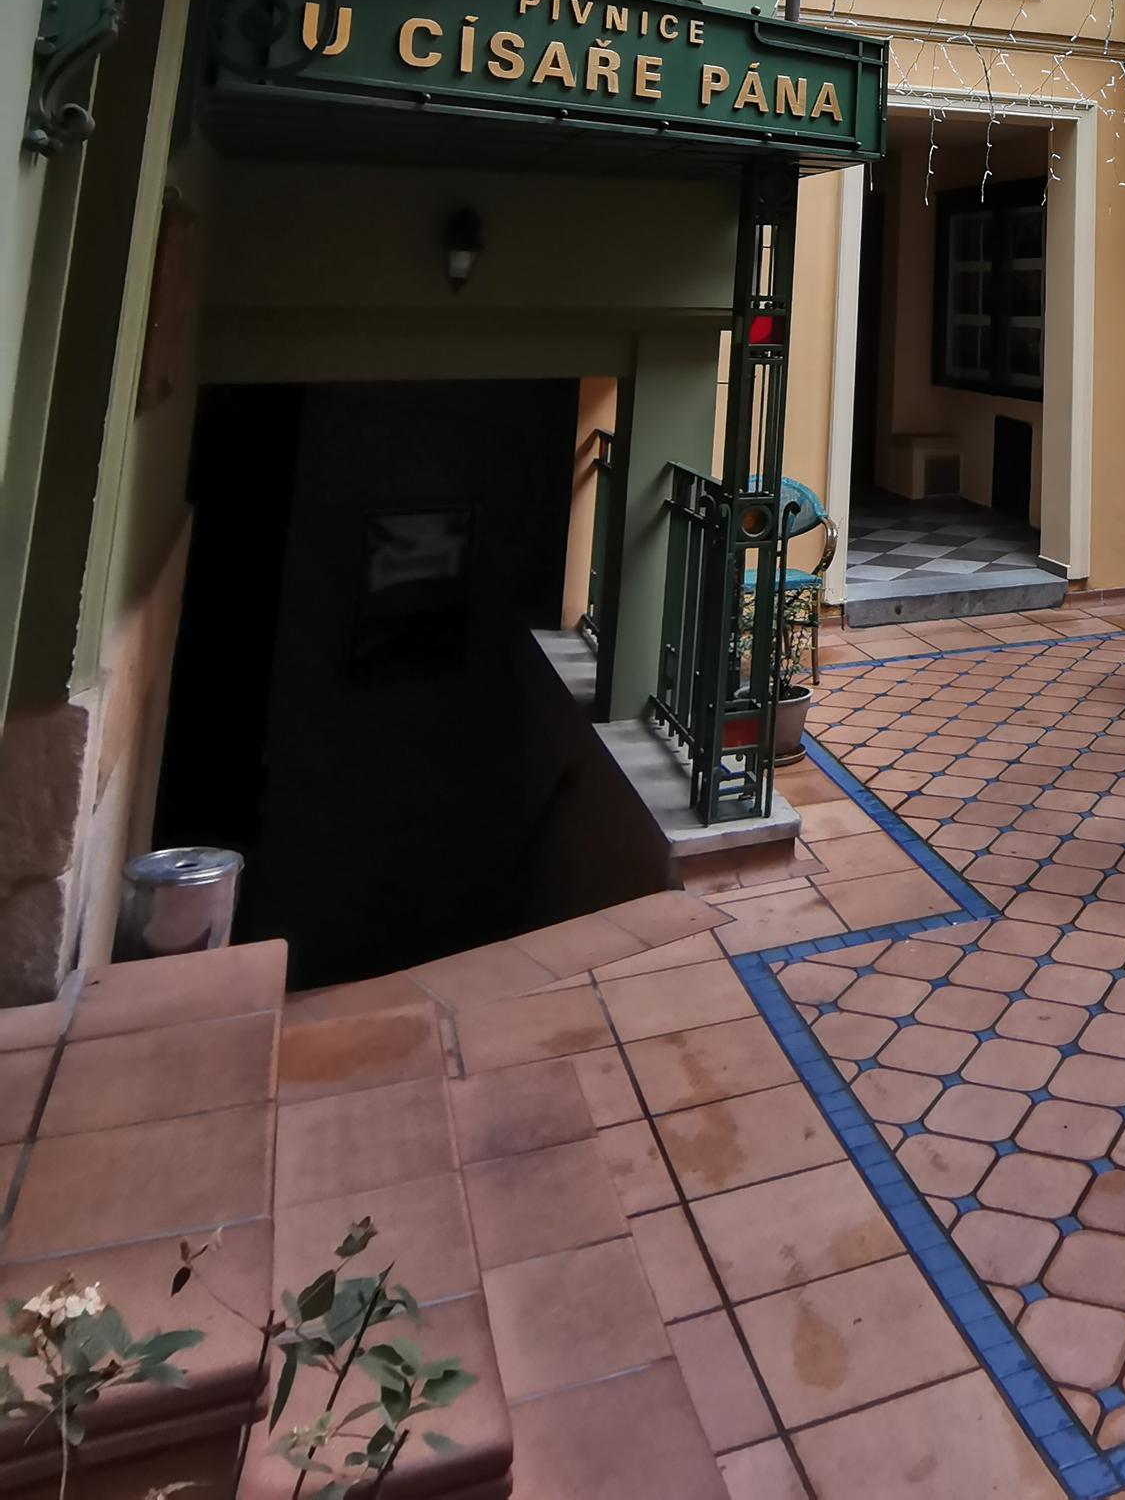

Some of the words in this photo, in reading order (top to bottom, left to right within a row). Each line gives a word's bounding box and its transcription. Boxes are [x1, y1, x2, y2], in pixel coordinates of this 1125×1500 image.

[302, 2, 353, 56] U
[399, 15, 663, 100] CÍSAŘE
[701, 62, 843, 122] PÁNA
